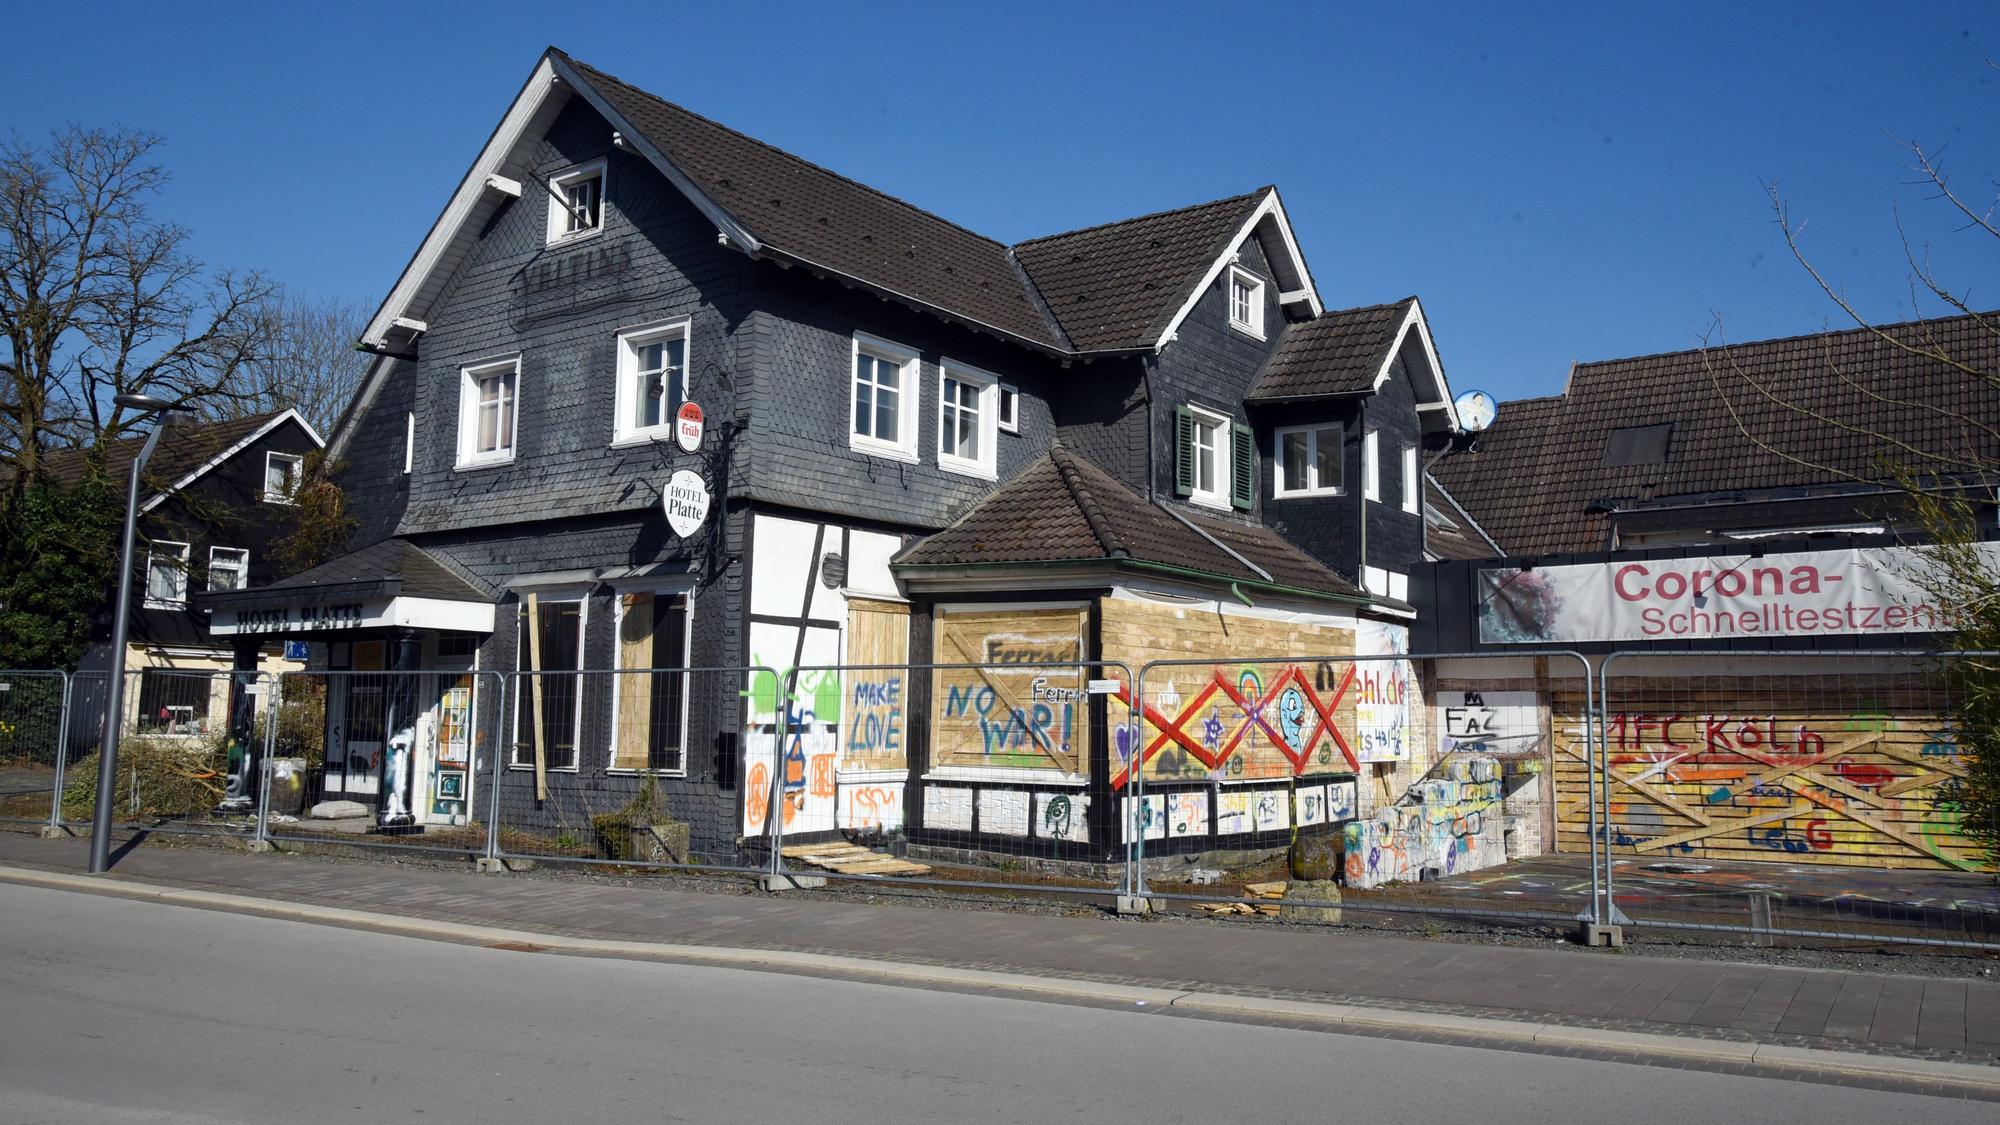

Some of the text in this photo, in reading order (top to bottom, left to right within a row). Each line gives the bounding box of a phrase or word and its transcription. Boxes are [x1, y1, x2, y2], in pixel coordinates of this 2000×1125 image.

[669, 499, 702, 520] Platte
[670, 486, 704, 504] HOTEL
[1614, 563, 1843, 602] Corona-
[237, 604, 363, 633] HOTEL PLATTE
[854, 677, 901, 706] MAKE
[943, 684, 997, 719] NO
[849, 708, 903, 752] LOVE
